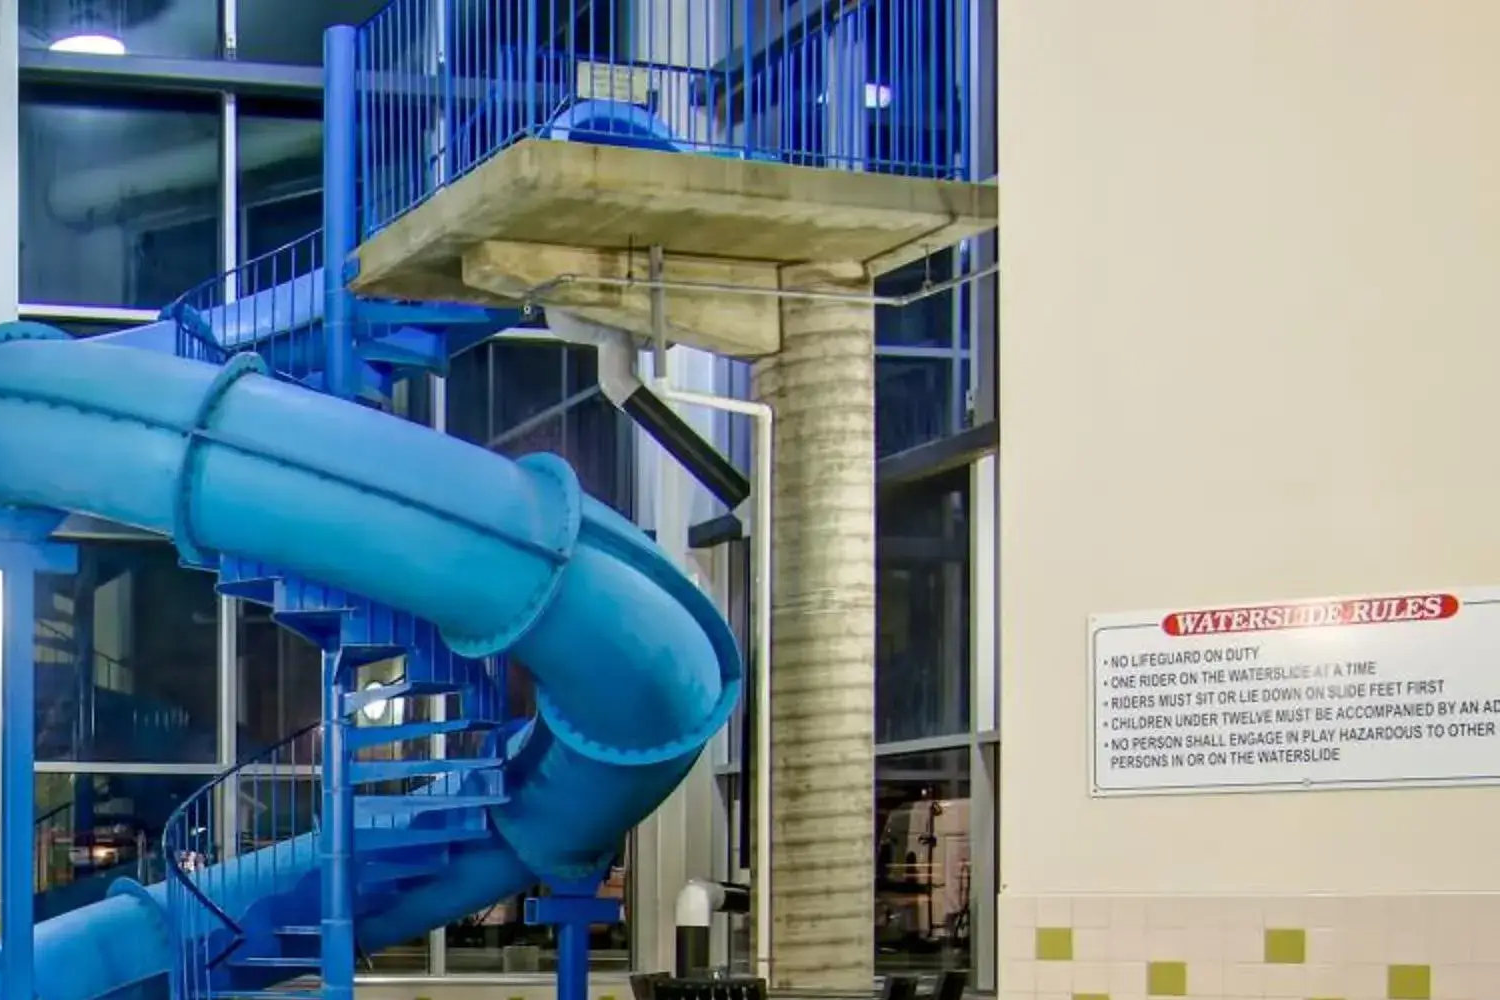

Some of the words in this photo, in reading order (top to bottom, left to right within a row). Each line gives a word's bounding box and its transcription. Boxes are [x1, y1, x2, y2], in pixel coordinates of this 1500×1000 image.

[1176, 603, 1343, 635] WATERSLIDE
[1351, 597, 1442, 623] RULES
[1111, 655, 1128, 668] NO
[1131, 650, 1200, 667] LIFEGUARD
[1203, 649, 1222, 663] ON
[1225, 646, 1260, 661] DUTY
[1111, 675, 1136, 688] ONE
[1139, 673, 1176, 687] RIDER
[1179, 671, 1198, 685] ON
[1202, 669, 1225, 683] THE
[1228, 665, 1309, 682] WATERSLIDE
[1310, 663, 1329, 677] AT
[1333, 662, 1343, 676] A
[1346, 661, 1377, 675] TIME
[1111, 695, 1155, 709] RIDERS
[1158, 693, 1192, 707] MUST
[1195, 691, 1215, 705] SIT
[1217, 690, 1236, 704] OR
[1239, 689, 1258, 703] LIE
[1262, 687, 1301, 702] DOWN
[1305, 686, 1325, 700] ON
[1327, 683, 1366, 699] SLIDE
[1369, 681, 1403, 697] FEET
[1407, 679, 1445, 695] FIRST
[1111, 714, 1172, 730] CHILDREN
[1175, 712, 1218, 728] UNDER
[1221, 710, 1273, 725] TWELVE
[1275, 707, 1312, 723] MUST
[1315, 707, 1333, 721] BE
[1336, 702, 1434, 719] ACCOMPANIED
[1437, 701, 1455, 715] BY
[1459, 701, 1479, 714] AN
[1111, 737, 1129, 751] NO
[1132, 735, 1183, 750] PERSON
[1185, 733, 1226, 748] SHALL
[1229, 731, 1283, 746] ENGAGE
[1286, 730, 1299, 743] IN
[1302, 729, 1336, 743] PLAY
[1339, 725, 1423, 742] HAZARDOUS
[1427, 724, 1445, 738] TO
[1447, 722, 1495, 737] OTHER
[1111, 754, 1169, 769] PERSONS
[1171, 754, 1185, 767] IN
[1187, 753, 1205, 767] OR
[1207, 752, 1227, 766] ON
[1230, 751, 1254, 765] THE
[1257, 748, 1341, 764] WATERSLIDE
